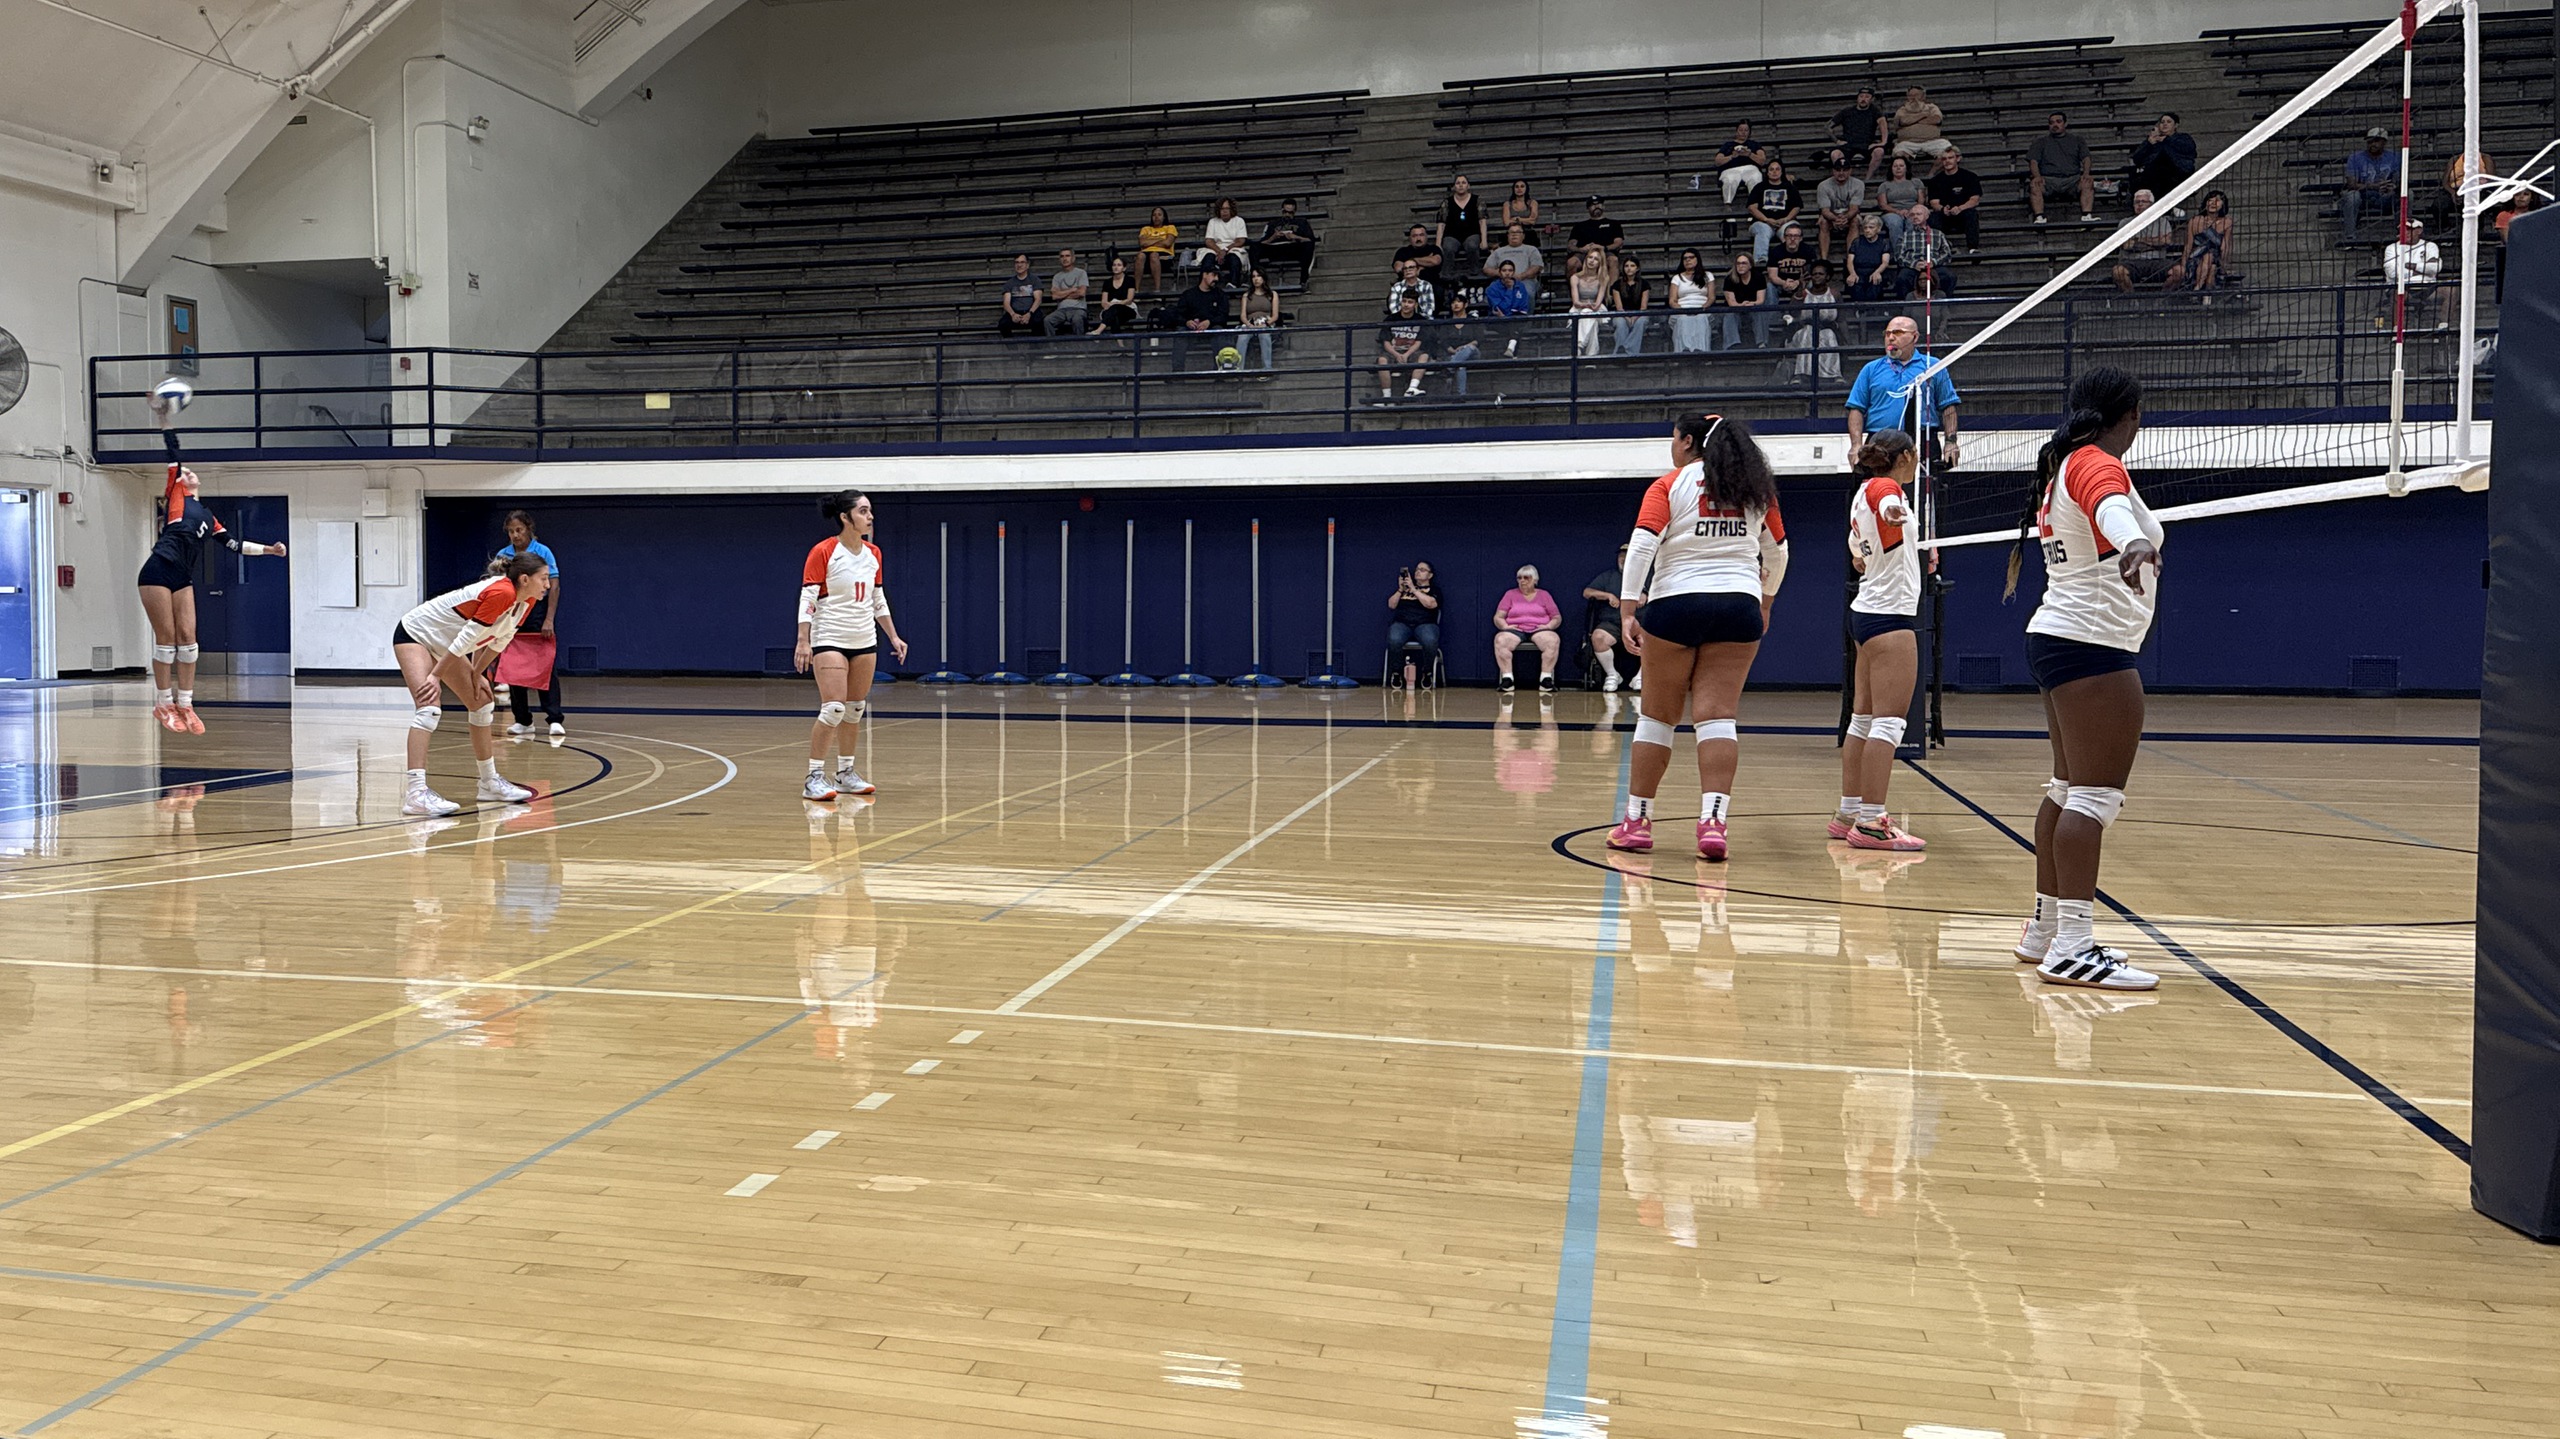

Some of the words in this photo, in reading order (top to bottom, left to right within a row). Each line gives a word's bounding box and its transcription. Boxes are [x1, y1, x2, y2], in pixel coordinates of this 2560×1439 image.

[196, 521, 208, 538] 5
[1695, 521, 1747, 537] CITRUS
[855, 581, 866, 602] 11
